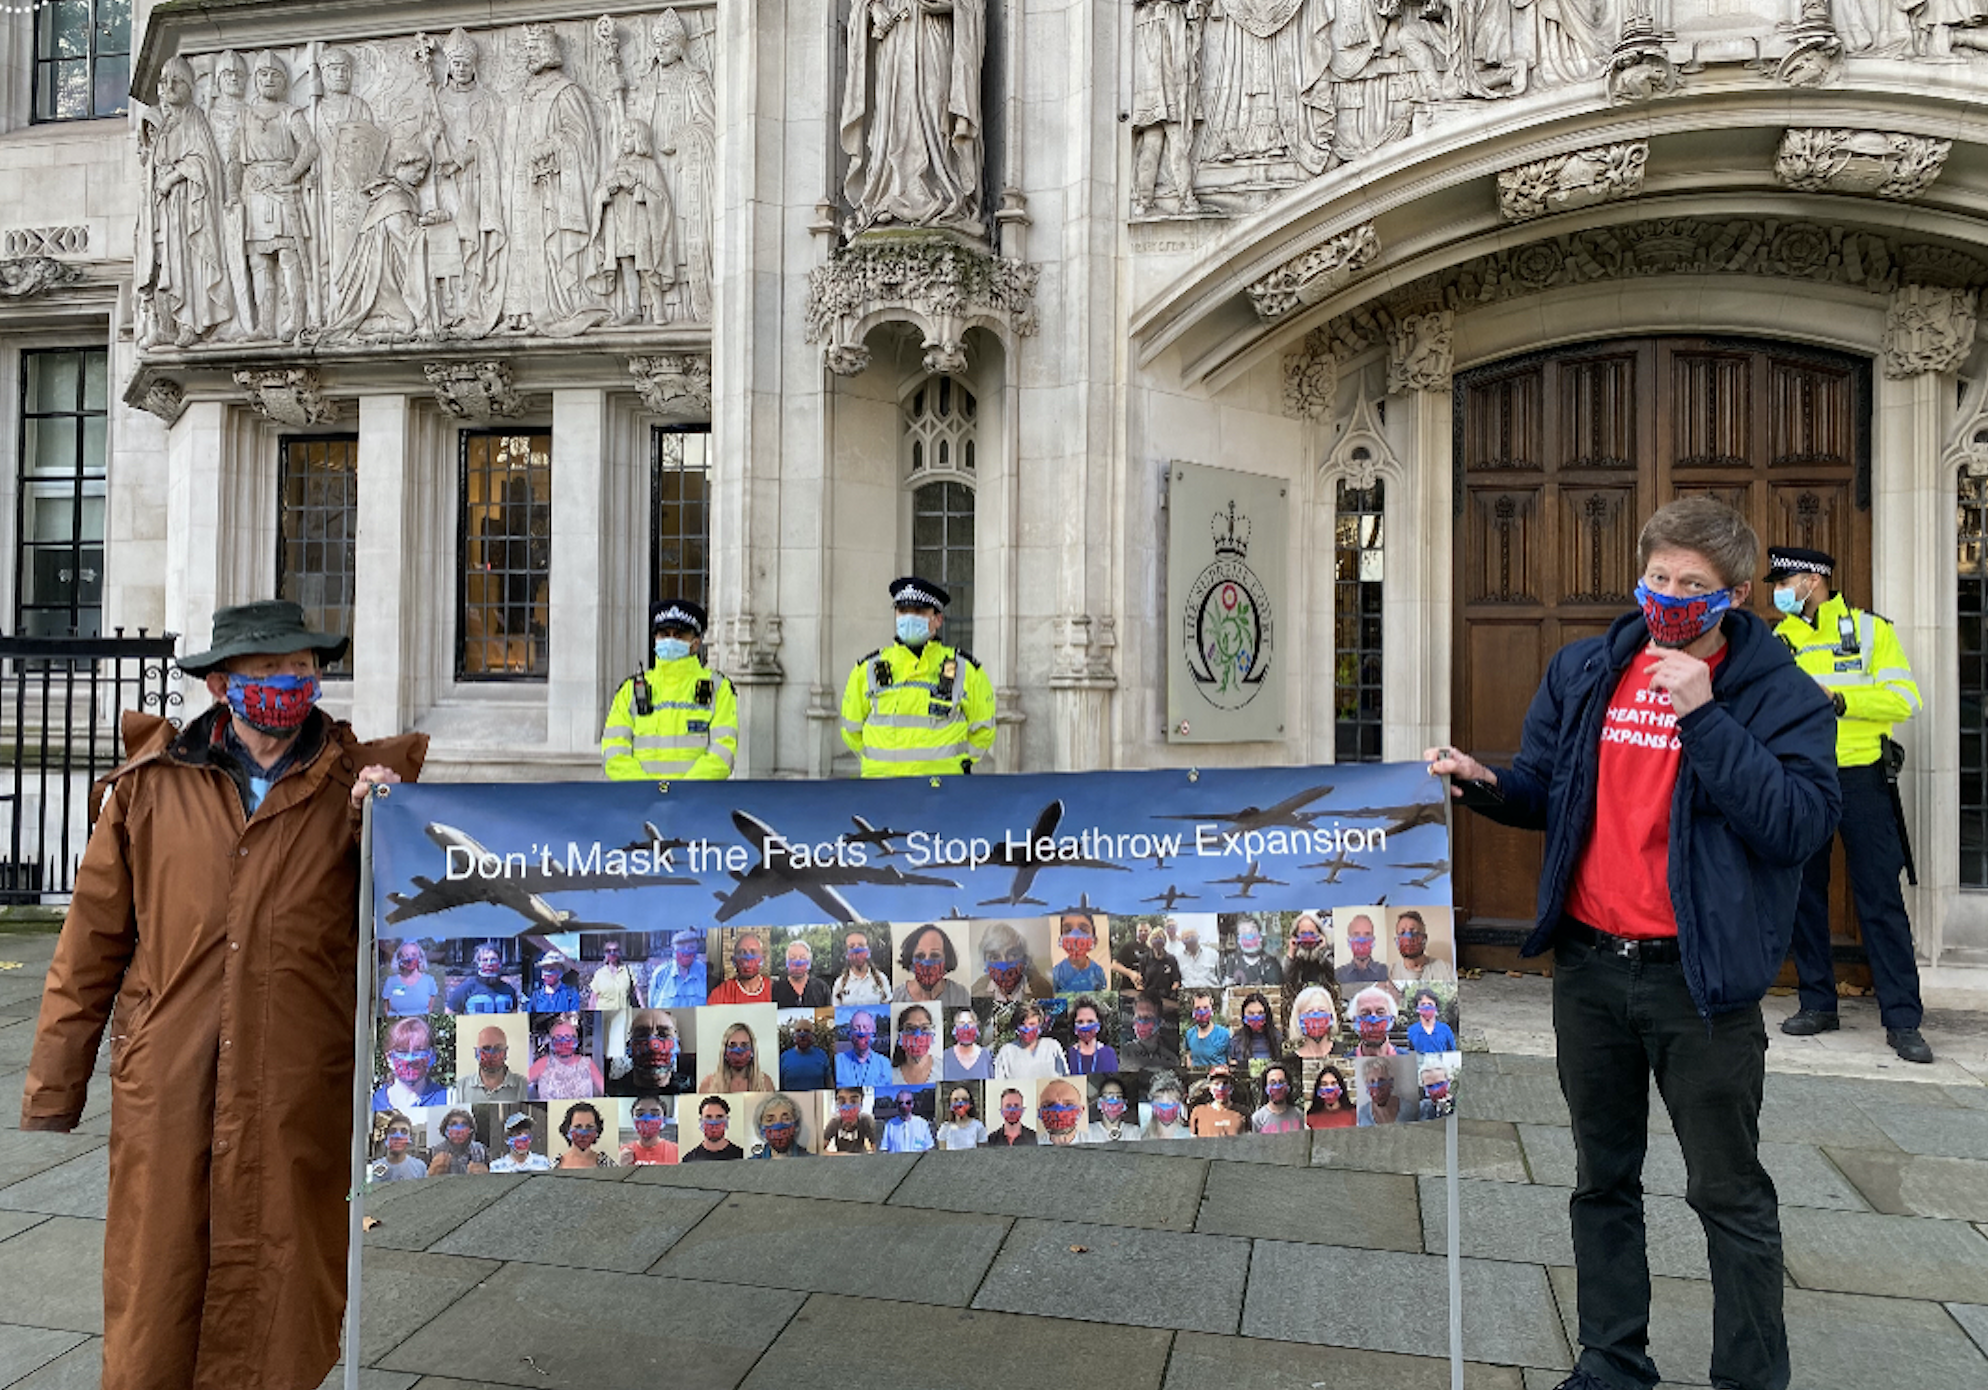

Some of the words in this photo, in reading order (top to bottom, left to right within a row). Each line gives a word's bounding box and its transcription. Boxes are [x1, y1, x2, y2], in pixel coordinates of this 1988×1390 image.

[1643, 595, 1707, 625] STOP
[242, 681, 313, 709] STOP
[1634, 689, 1671, 706] STO
[1606, 706, 1681, 731] HEATHR
[1601, 726, 1682, 750] EXPANSO
[567, 840, 674, 877] Mask
[687, 838, 749, 872] the
[763, 834, 867, 871] Facts
[904, 830, 991, 872] Stop
[1005, 825, 1182, 863] Heathrow
[1195, 822, 1387, 863] Expansion
